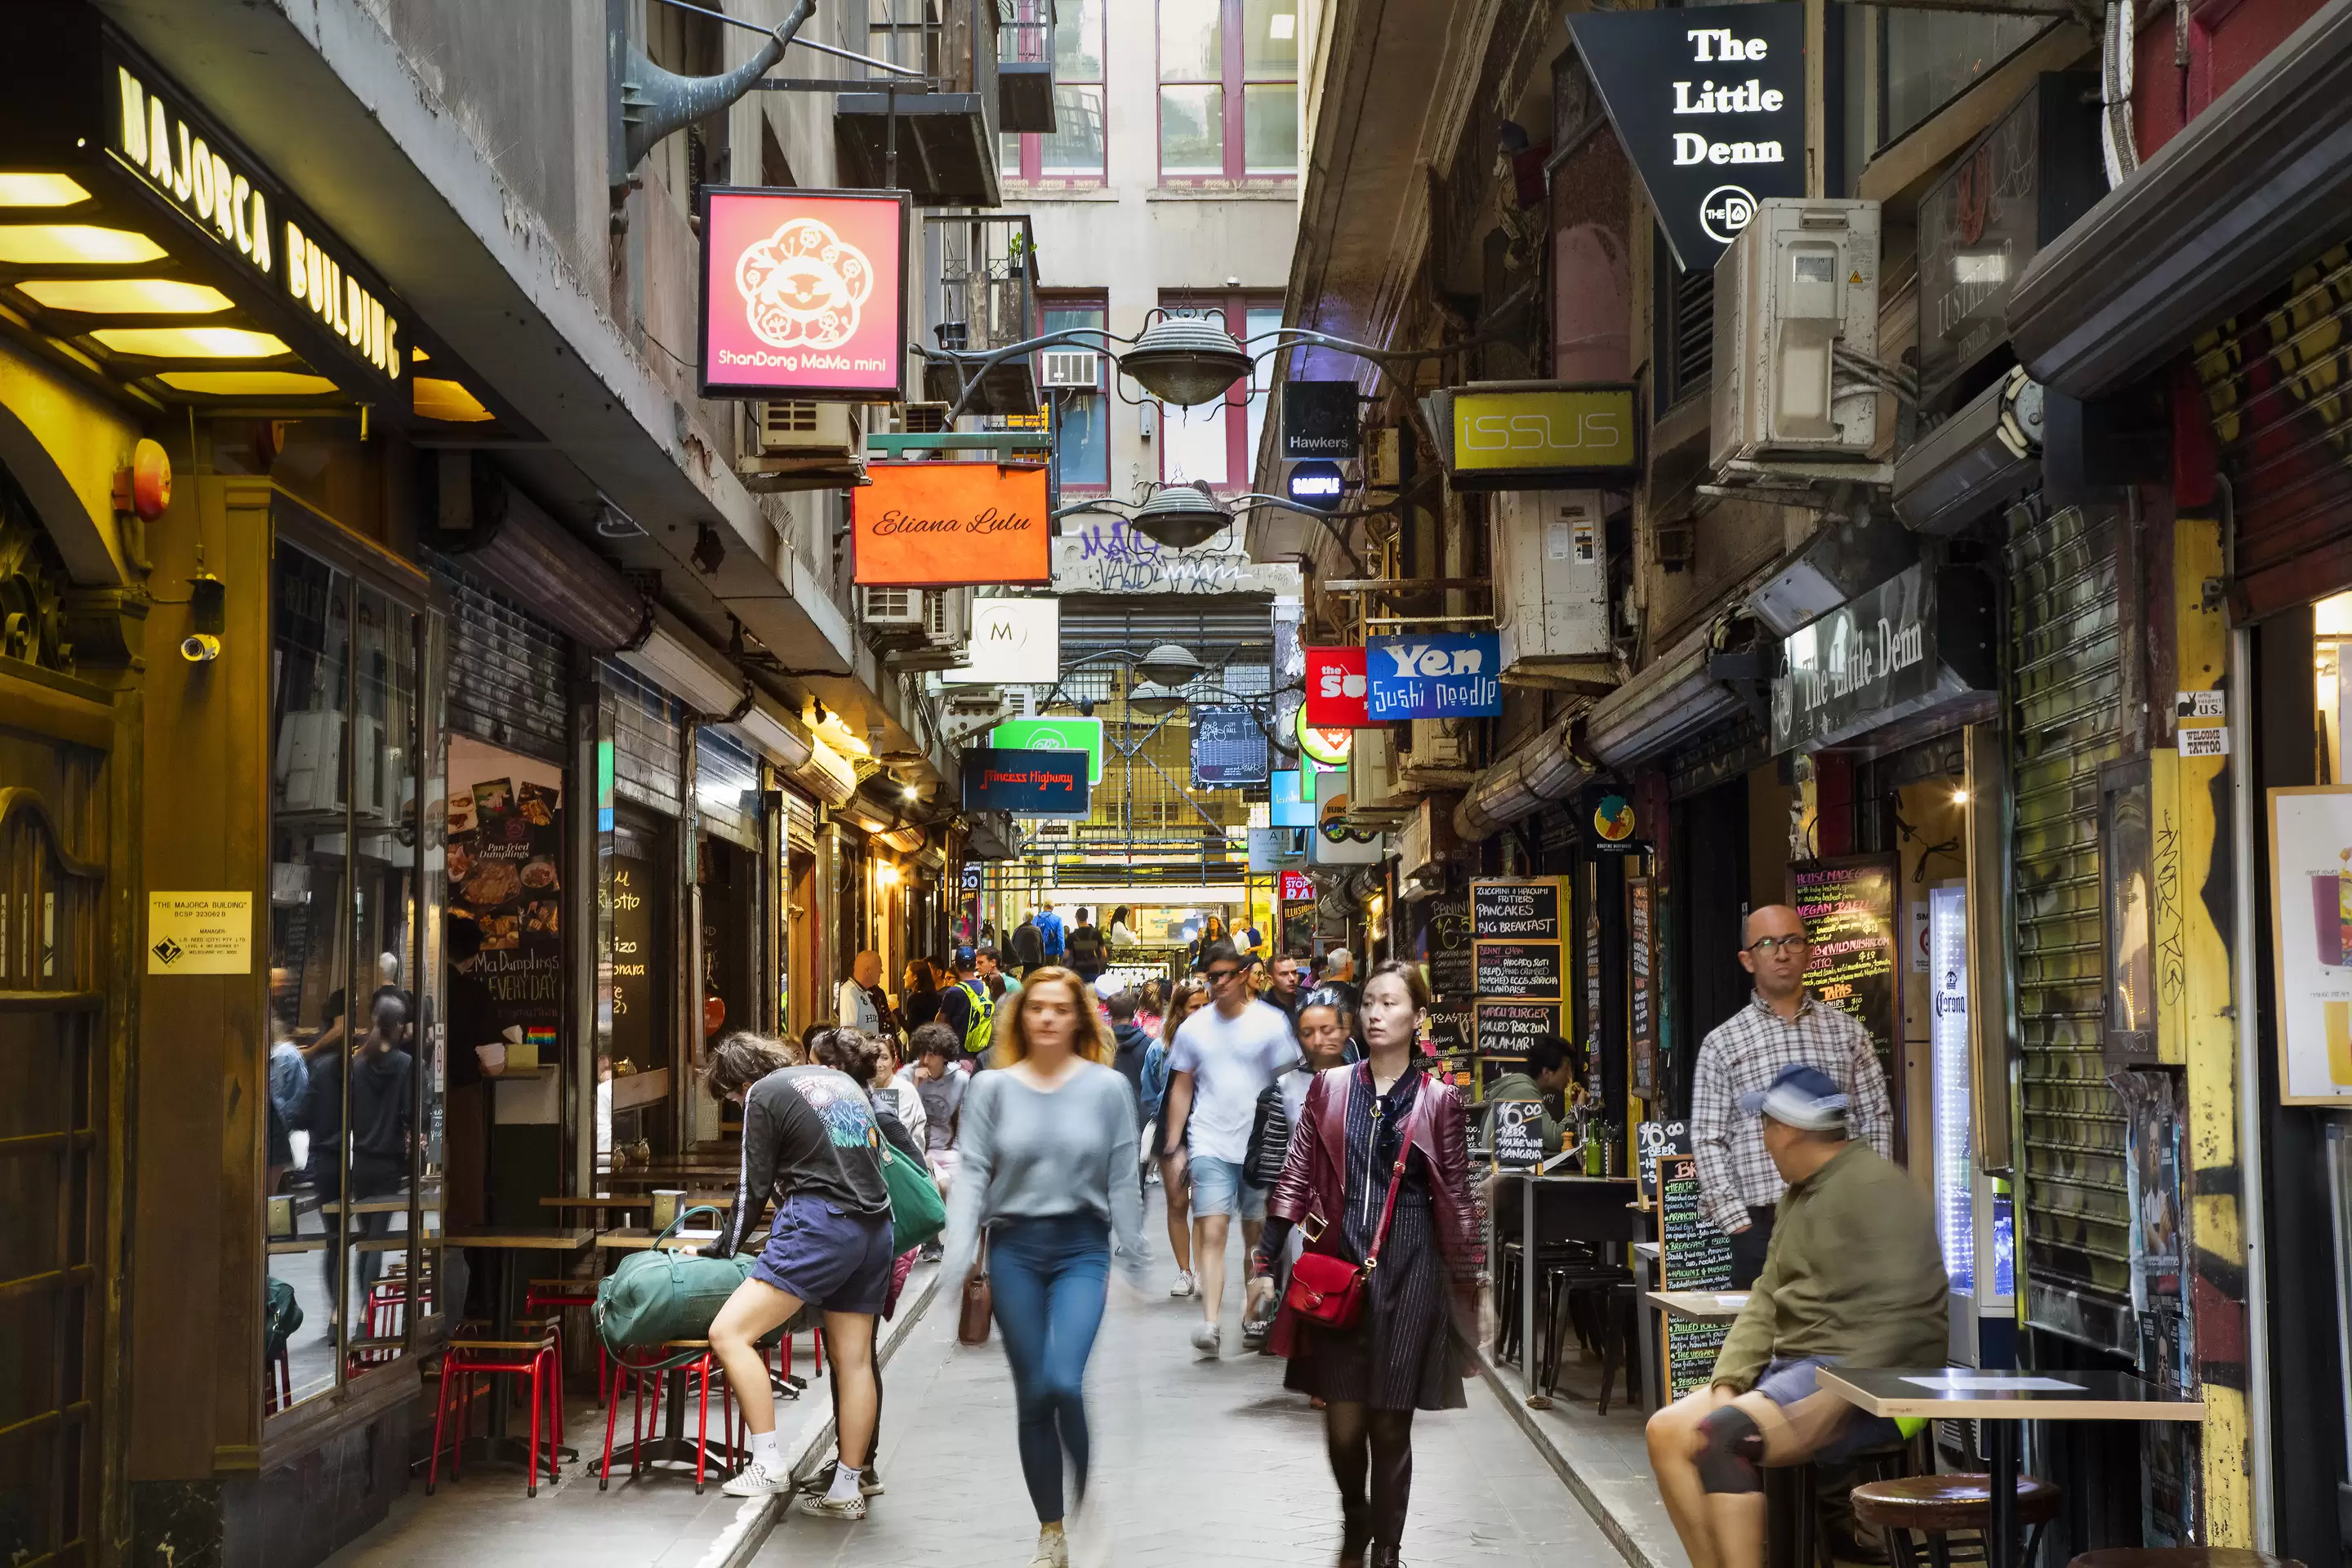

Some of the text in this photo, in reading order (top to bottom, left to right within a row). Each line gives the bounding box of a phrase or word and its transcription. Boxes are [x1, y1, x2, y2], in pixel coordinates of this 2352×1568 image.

[1687, 29, 1768, 62] The
[1673, 79, 1784, 114] Little
[1673, 132, 1784, 165] Denn
[1706, 208, 1726, 220] THE
[118, 65, 400, 380] MAJORCA BUILDING
[718, 350, 886, 372] ShanDong MaMa mini
[1290, 436, 1348, 448] Hawkers
[872, 507, 1031, 536] Eliana Lulu
[991, 621, 1013, 640] M
[1383, 644, 1482, 678] Yen
[1802, 653, 1829, 712] The
[1878, 617, 1923, 679] Denn
[1321, 666, 1342, 675] the
[1373, 680, 1424, 713] Sushi
[2198, 704, 2222, 715] us.
[2186, 729, 2220, 741] WELCOME
[2187, 740, 2221, 755] TATTOO
[980, 769, 1073, 791] Princess Highway
[479, 849, 530, 859] Dumplings
[488, 842, 529, 853] Pan-fried
[1285, 880, 1307, 889] STOP
[1477, 887, 1510, 896] ZUCCHINI
[1498, 895, 1534, 904] FRITTERS
[1476, 903, 1535, 918] PANCAKES
[1797, 902, 1833, 916] VEGAN
[1477, 918, 1556, 933] BIG BREAKFAST
[1829, 937, 1891, 955] WILD MUSHROOM
[1478, 985, 1526, 994] HOLLANDAISE
[1936, 990, 1966, 1018] Corona
[1508, 1006, 1550, 1020] BURGER
[1479, 1019, 1550, 1034] PULLED PORK BUN
[1479, 1035, 1535, 1051] CALAMARI
[1670, 1240, 1708, 1251] BREAKFAST
[1690, 1348, 1714, 1358] VEGAN
[1677, 1377, 1698, 1387] PESTO
[844, 1472, 856, 1481] ck
